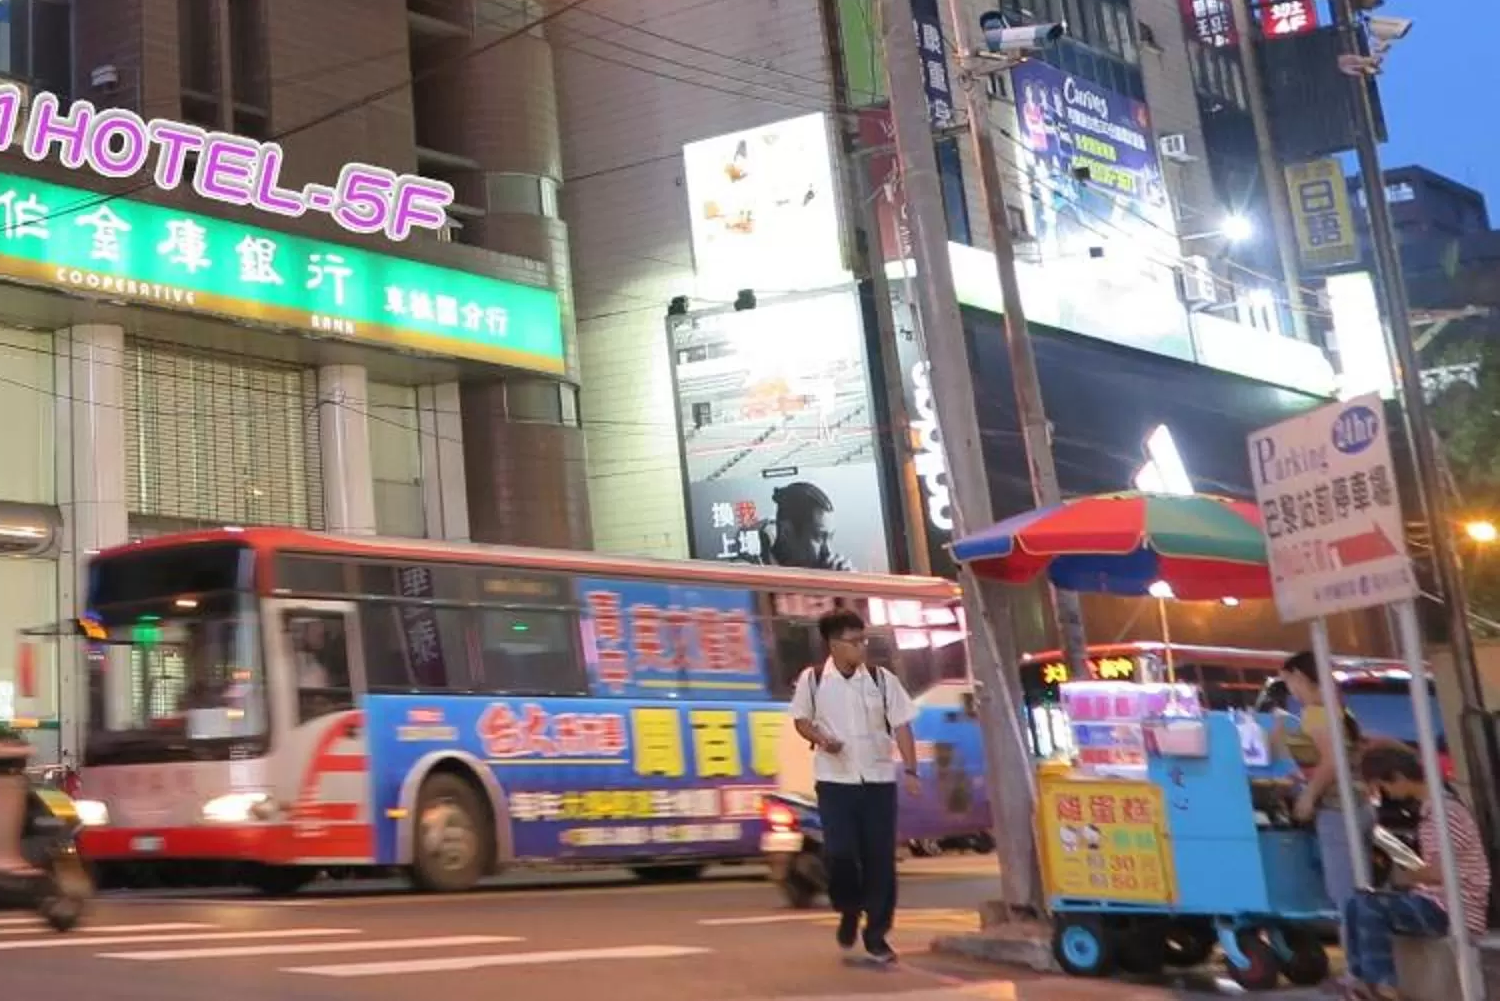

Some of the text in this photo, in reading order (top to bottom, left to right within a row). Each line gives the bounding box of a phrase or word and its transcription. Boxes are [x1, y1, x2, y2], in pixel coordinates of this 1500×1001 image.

[56, 266, 197, 306] COOPERATIVE
[311, 313, 356, 336] BANK
[1255, 436, 1329, 485] Parking
[1057, 793, 1153, 824] 雞蛋糕
